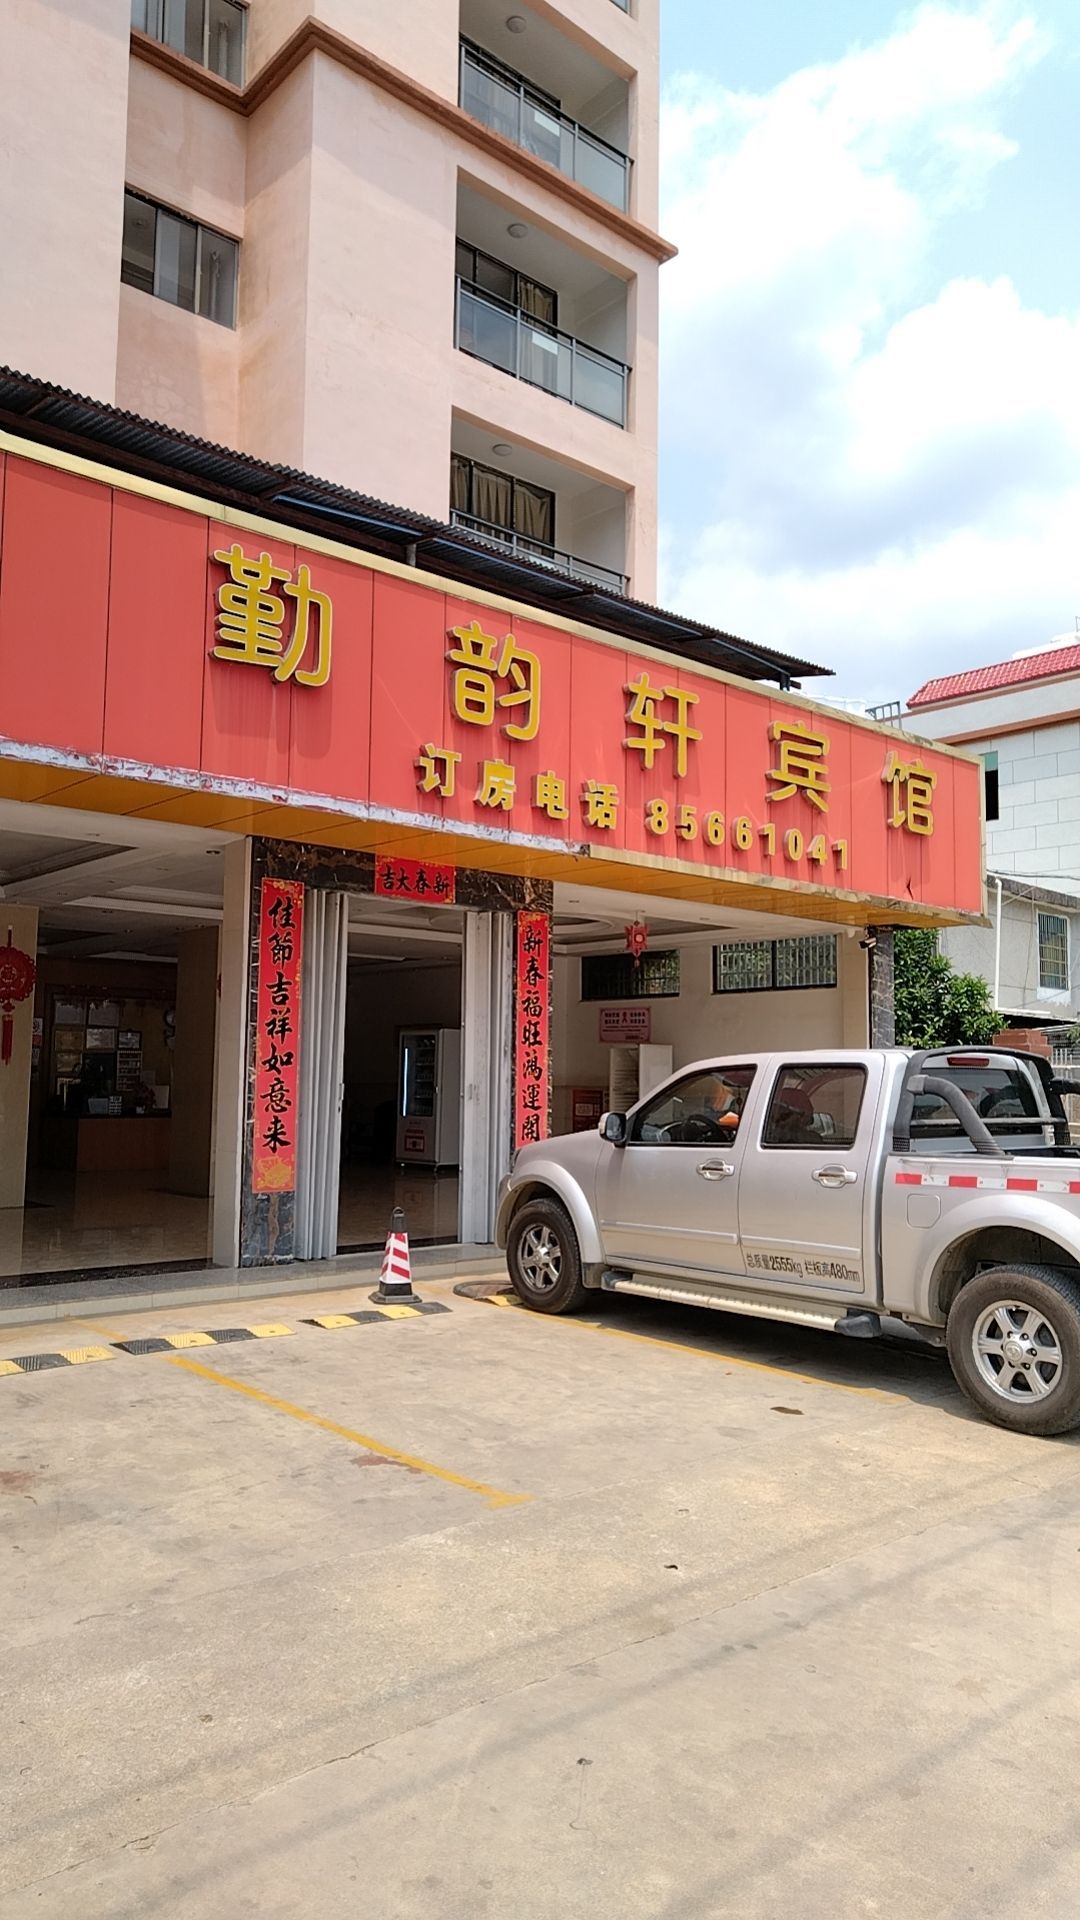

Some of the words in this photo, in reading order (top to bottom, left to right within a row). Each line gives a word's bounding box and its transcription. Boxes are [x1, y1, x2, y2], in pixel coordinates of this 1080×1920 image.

[210, 544, 937, 837] 勤韵轩宾馆
[415, 743, 619, 830] 订房电话
[645, 799, 848, 871] 85661041
[747, 1253, 803, 1278] 总质量2555kg
